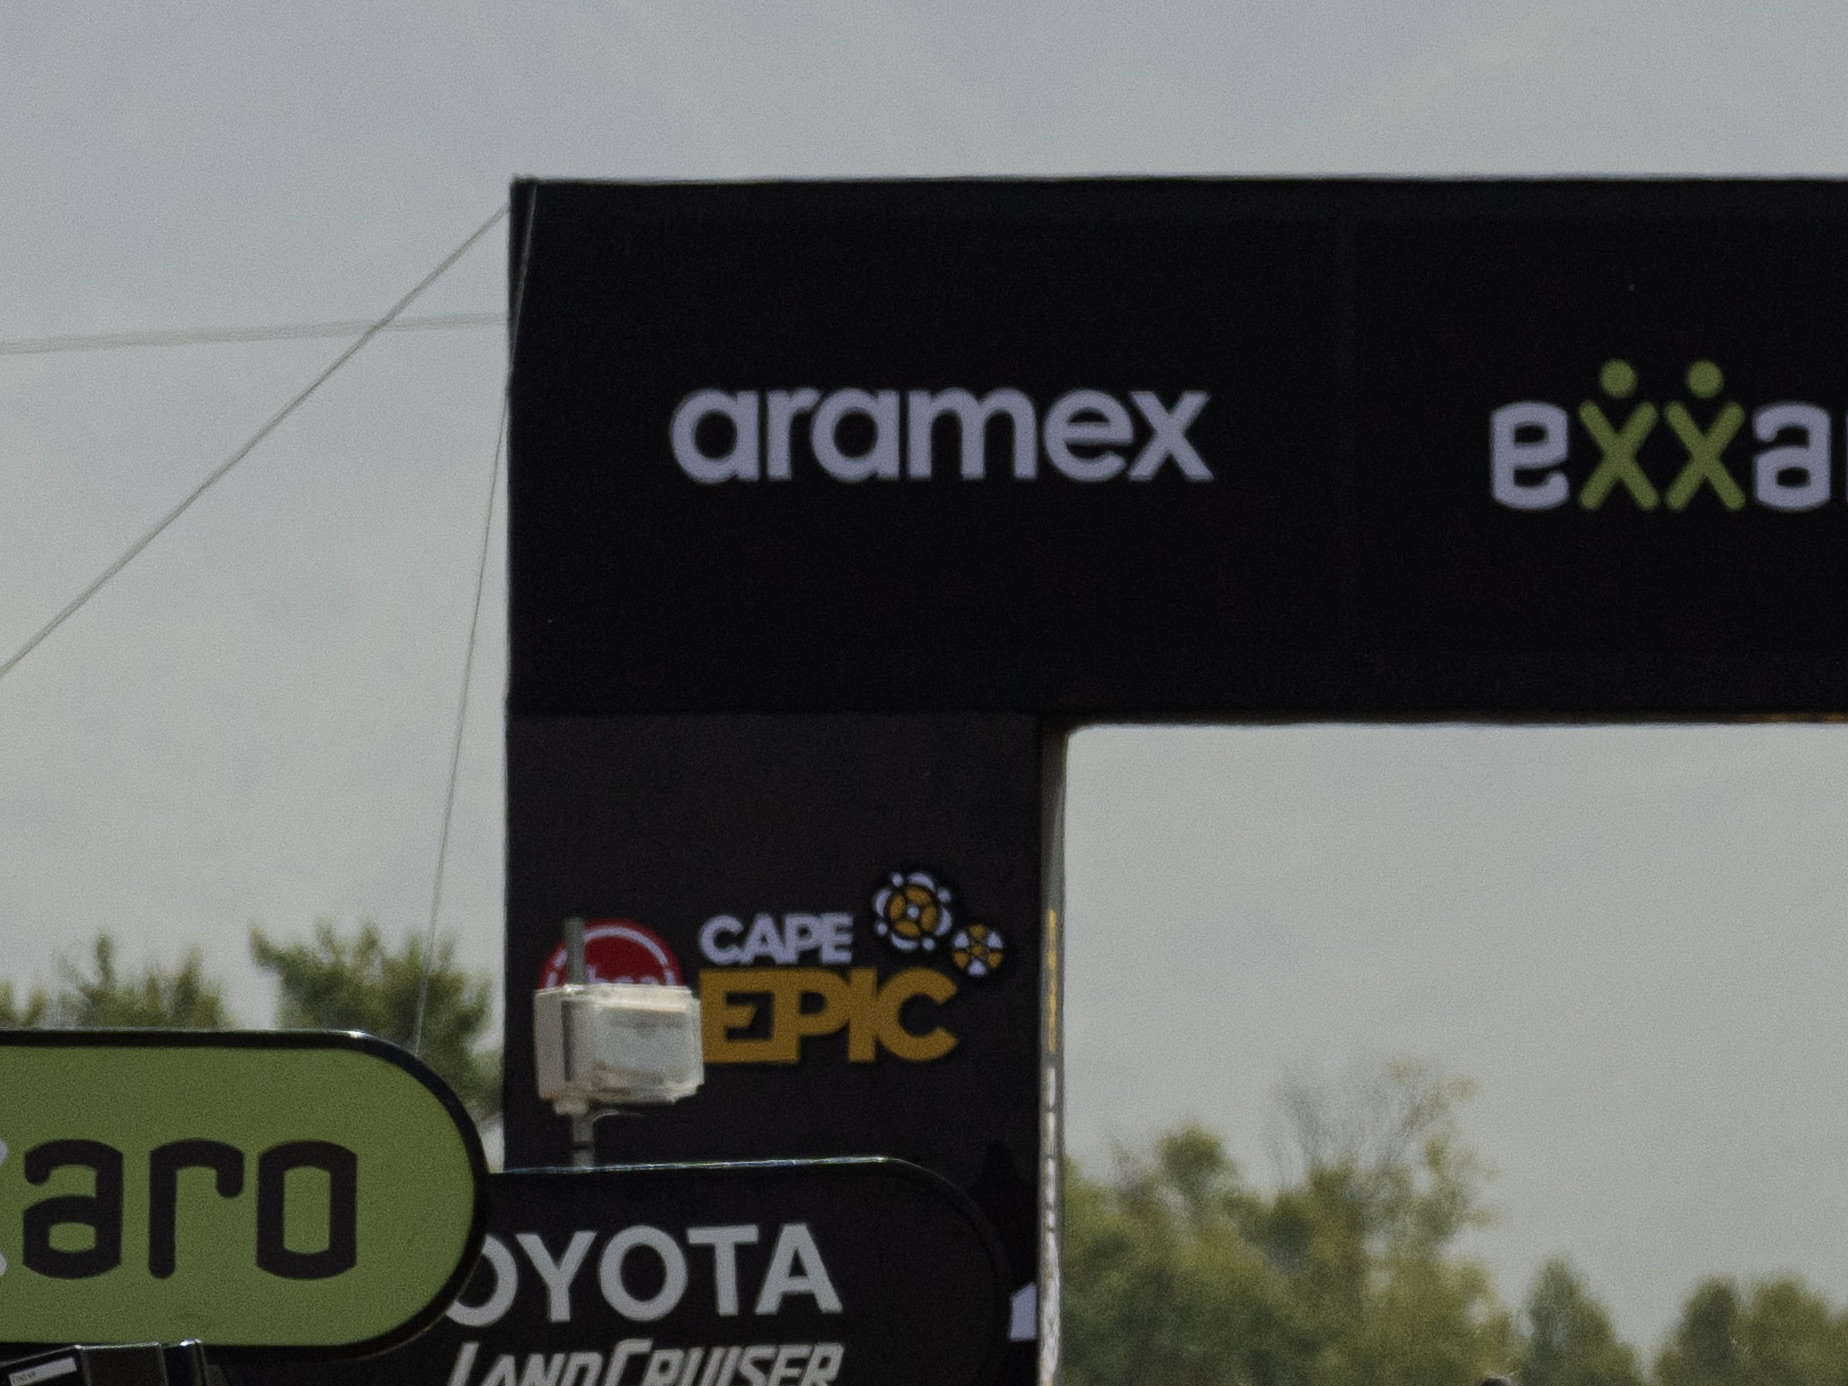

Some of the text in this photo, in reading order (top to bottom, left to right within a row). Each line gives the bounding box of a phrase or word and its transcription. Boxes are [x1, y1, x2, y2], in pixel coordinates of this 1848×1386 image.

[669, 387, 1214, 484] aramex
[697, 912, 853, 967] CAPE
[698, 967, 958, 1064] EPIC
[0, 1138, 358, 1281] aro
